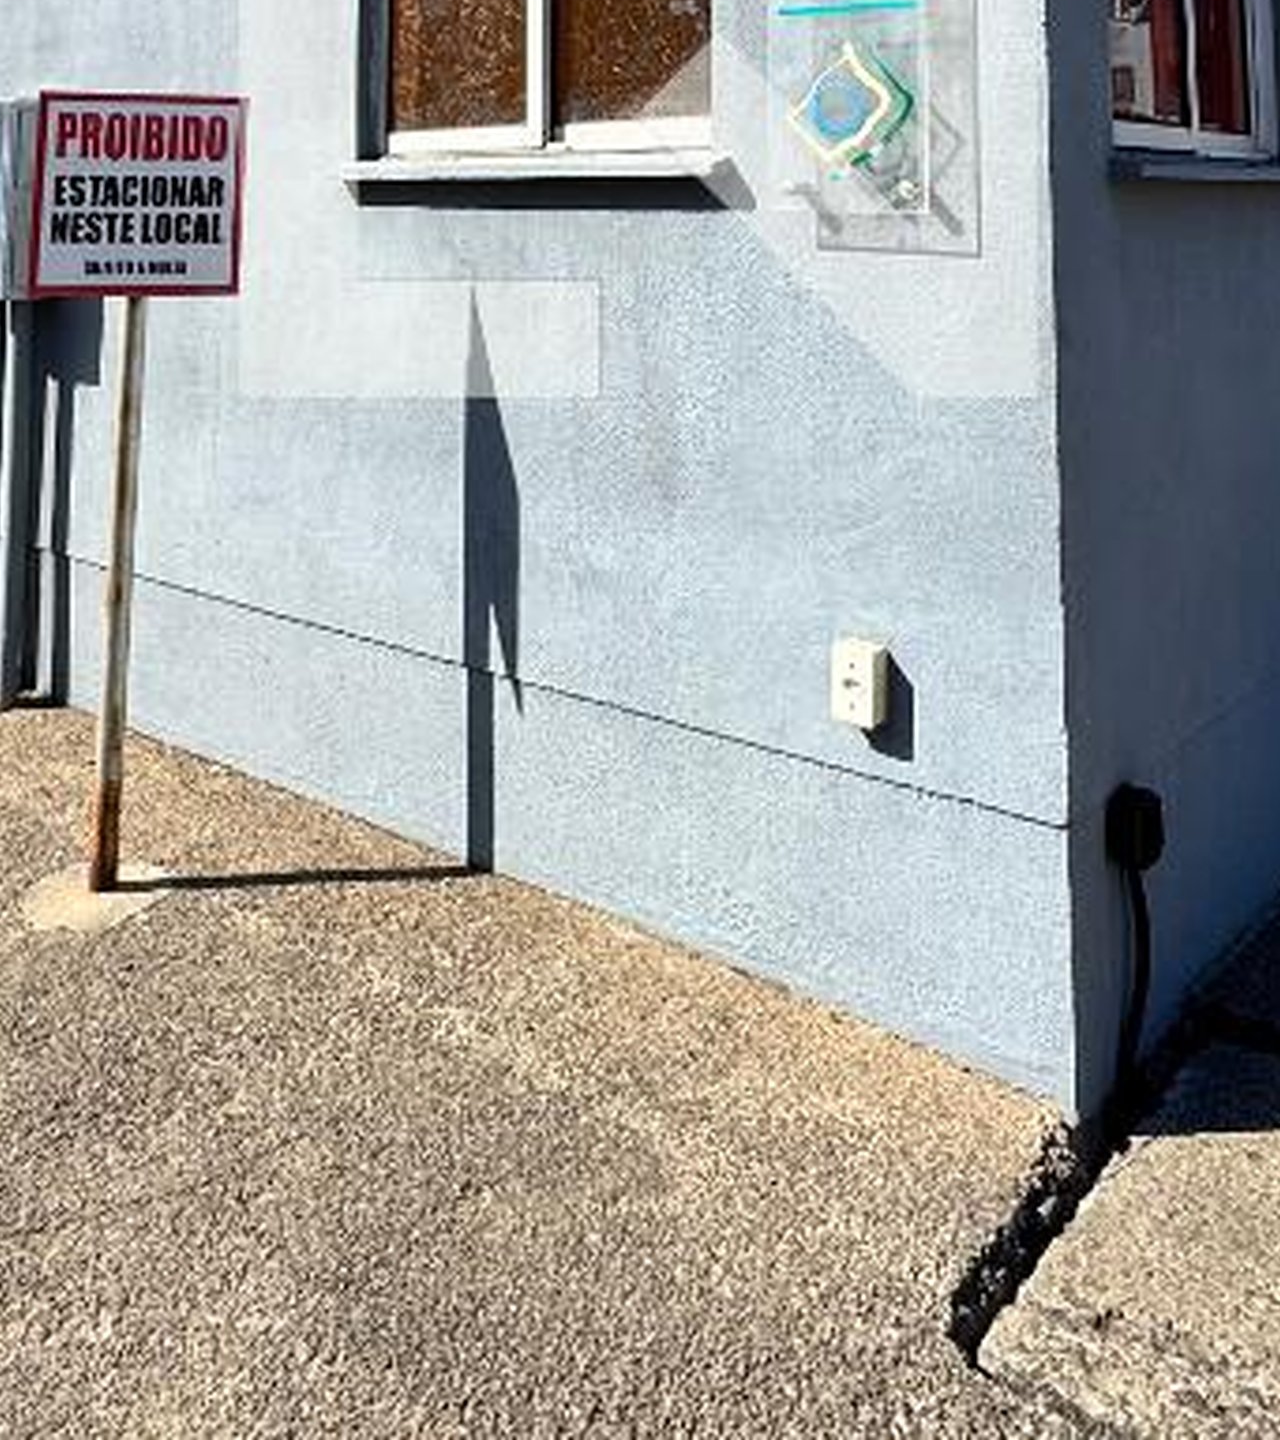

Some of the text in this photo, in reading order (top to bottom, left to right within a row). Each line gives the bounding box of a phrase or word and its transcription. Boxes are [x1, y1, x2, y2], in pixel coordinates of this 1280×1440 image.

[54, 112, 228, 161] PROIBIDO
[54, 175, 226, 208] ESTACIONAR
[49, 212, 222, 245] NESTE LOCAL
